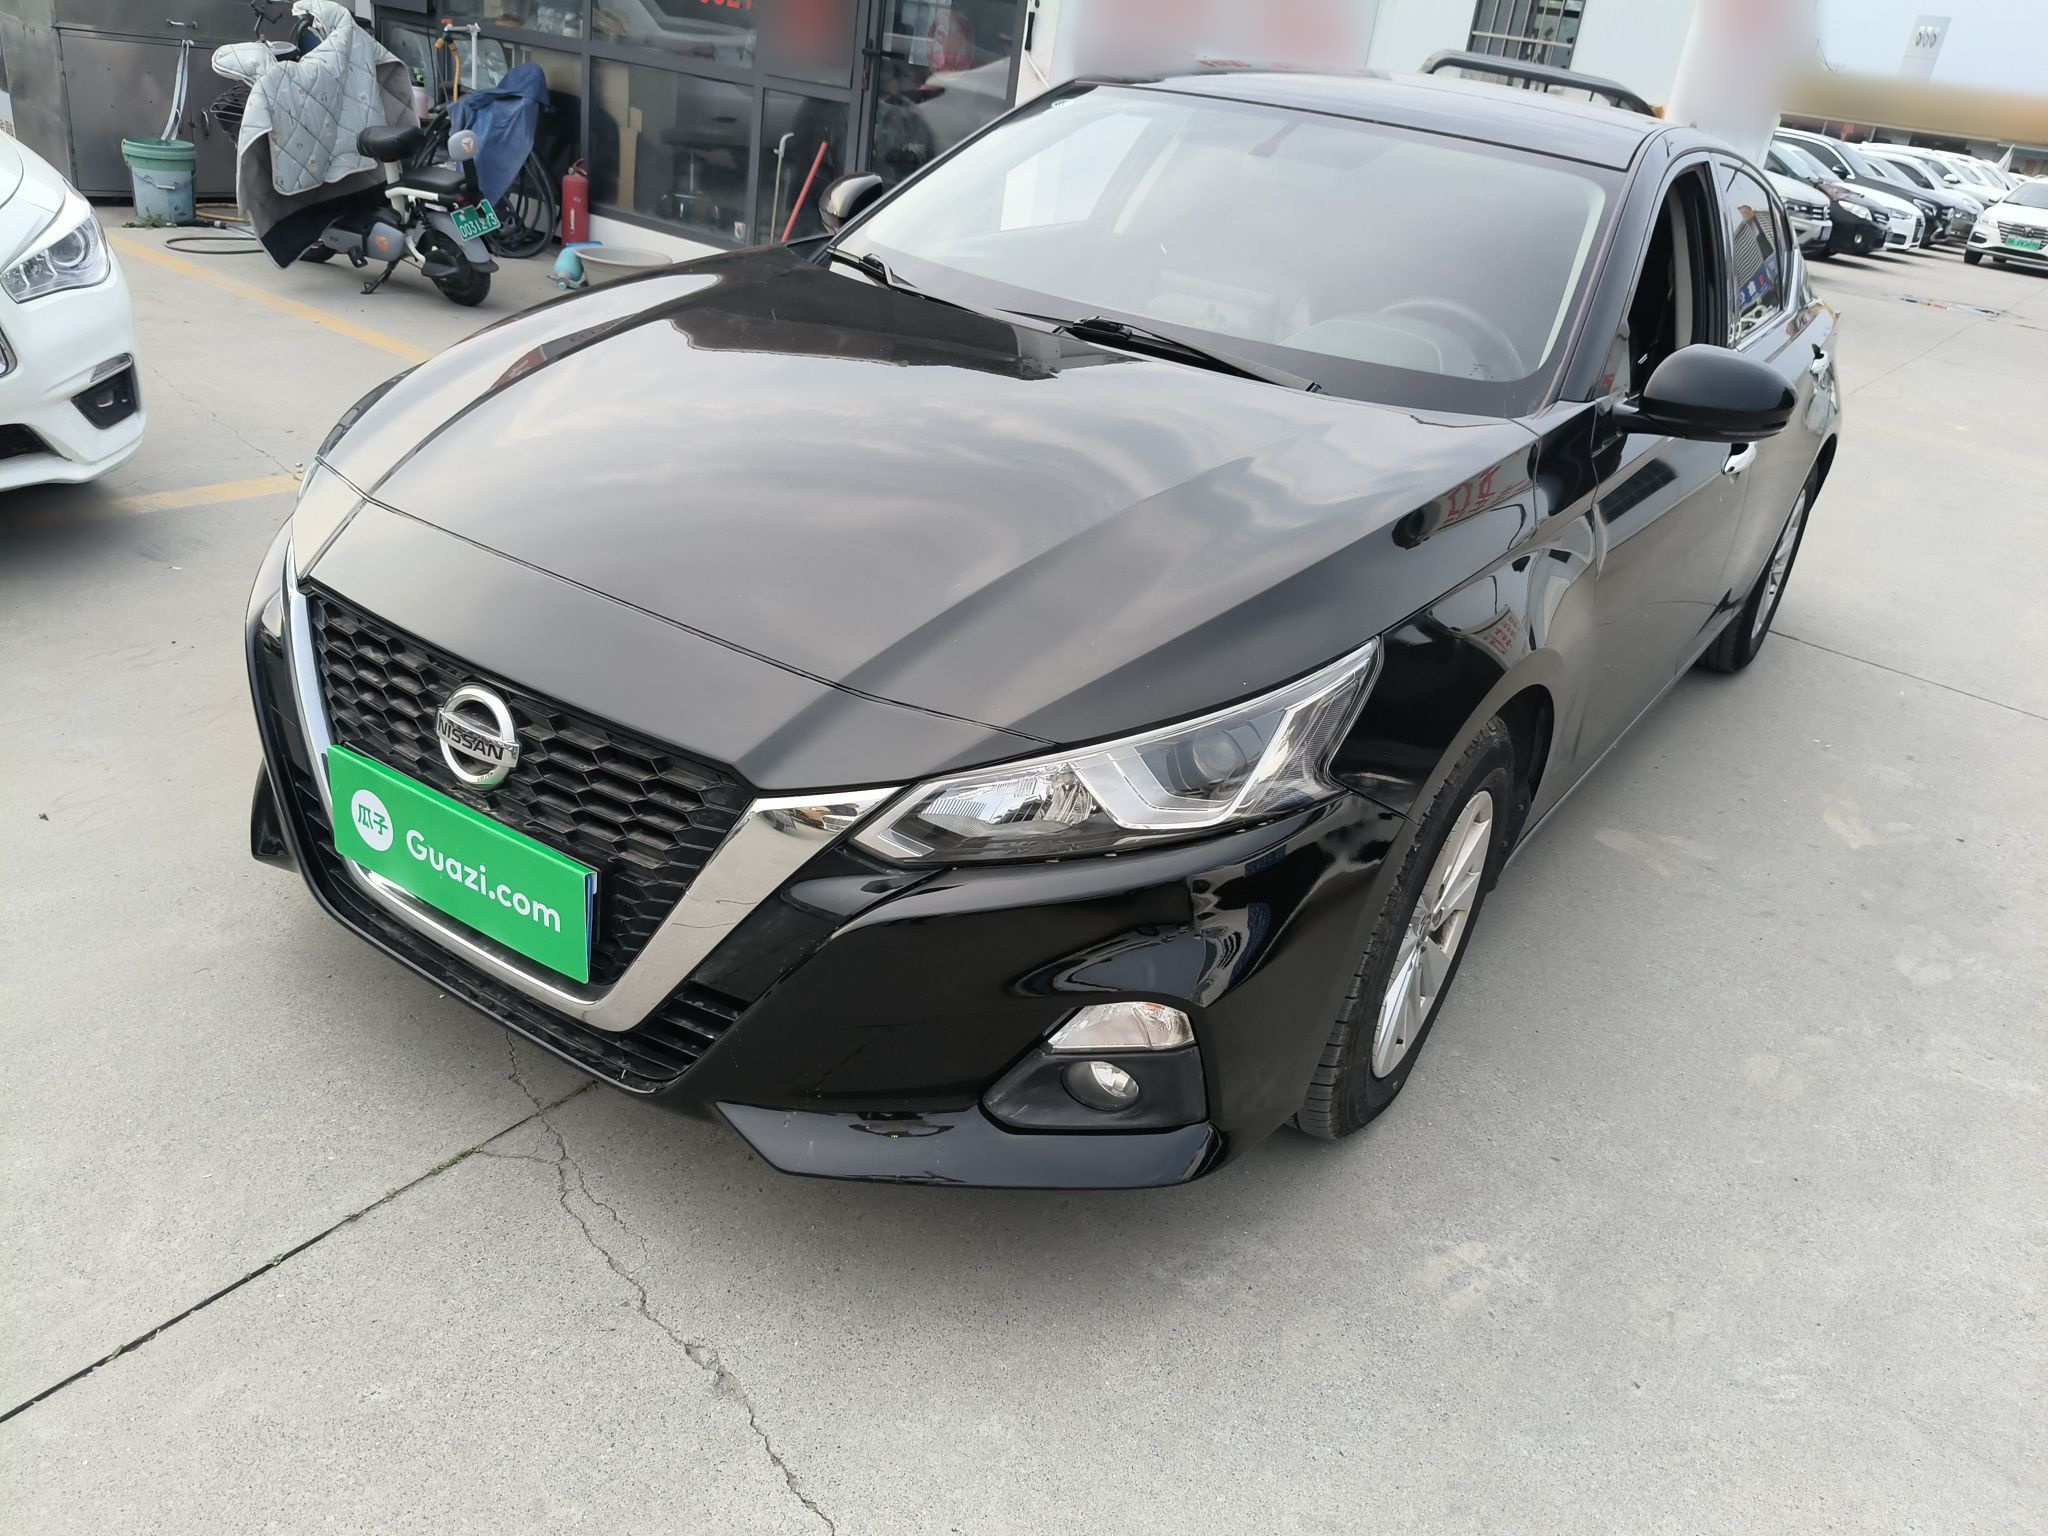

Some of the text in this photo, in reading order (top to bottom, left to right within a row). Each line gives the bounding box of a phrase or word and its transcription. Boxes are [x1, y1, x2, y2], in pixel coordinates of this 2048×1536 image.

[438, 716, 504, 760] NISSAN
[358, 803, 561, 933] 瓜子 Guazi.com
